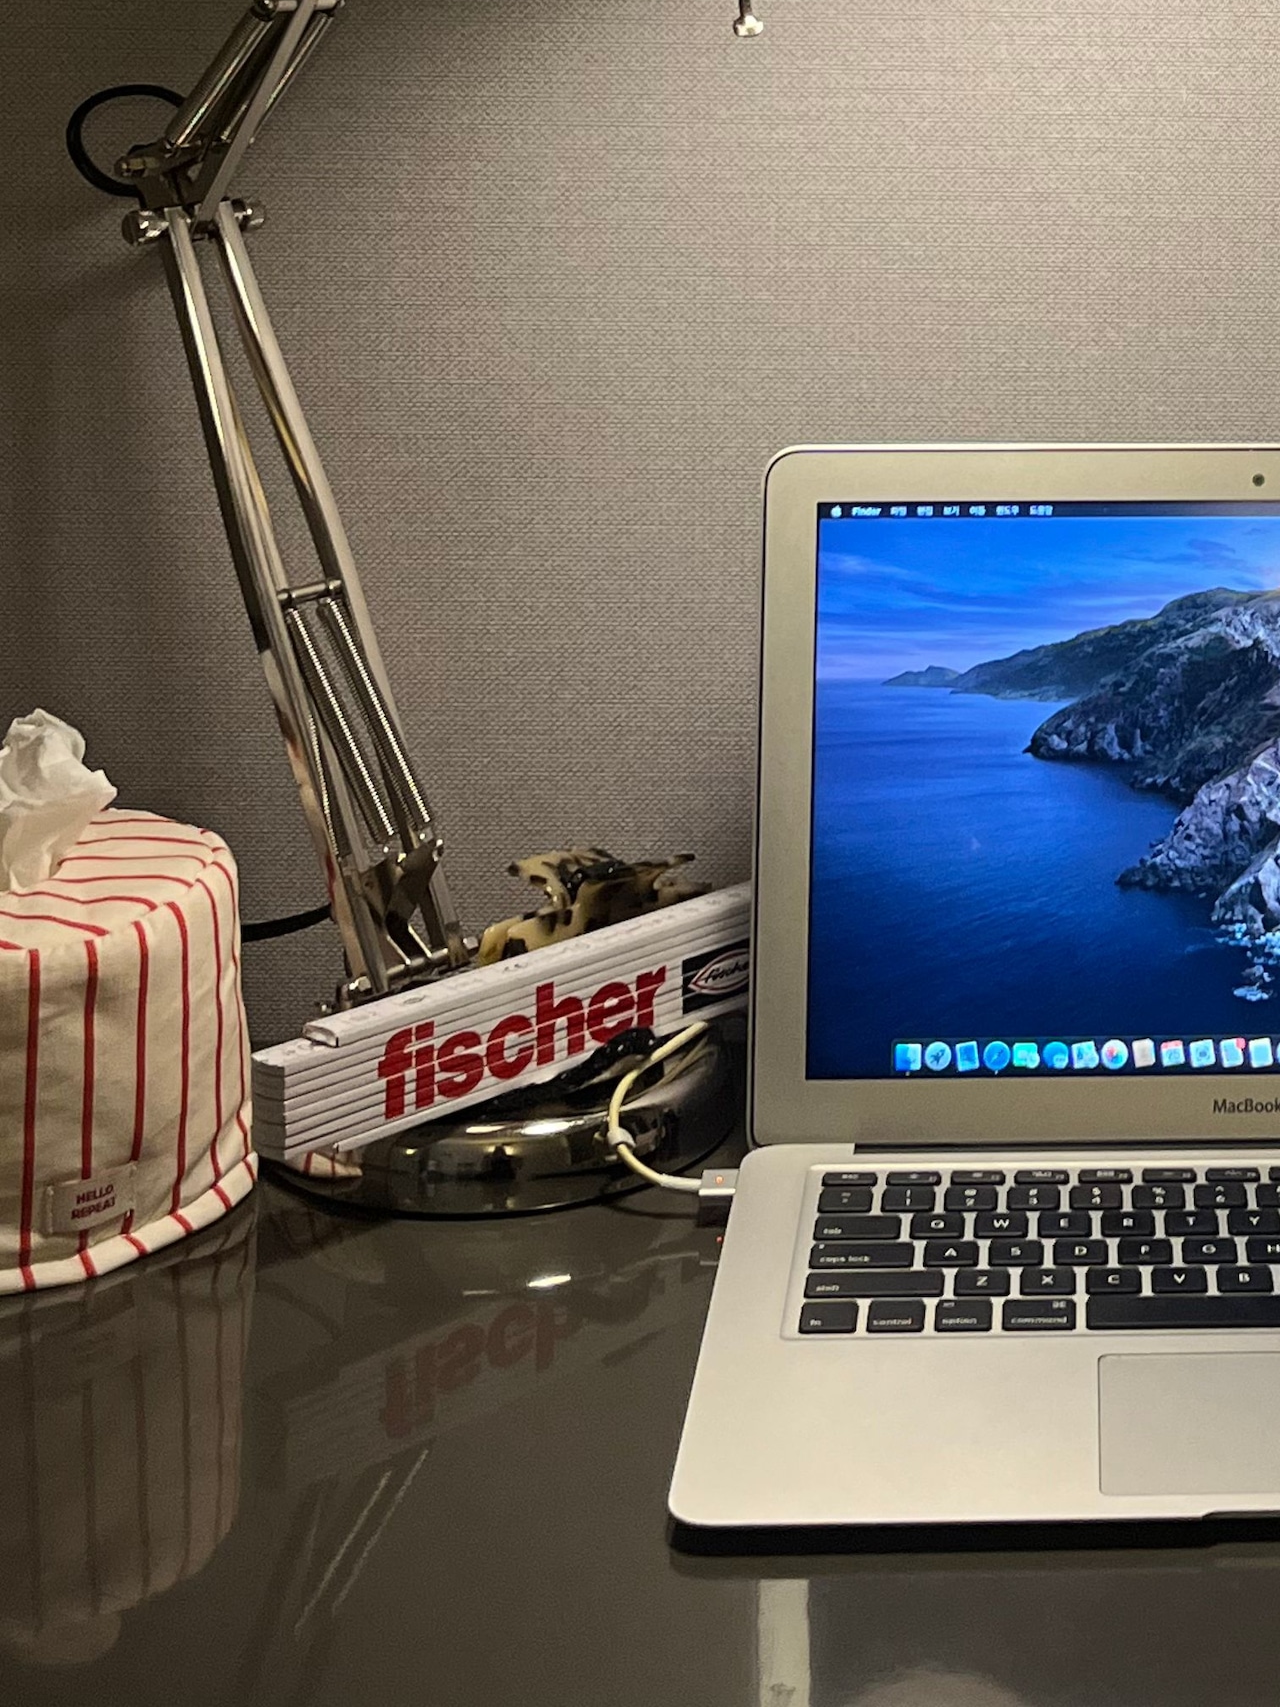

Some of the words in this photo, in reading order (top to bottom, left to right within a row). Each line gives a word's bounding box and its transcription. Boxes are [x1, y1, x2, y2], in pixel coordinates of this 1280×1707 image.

[378, 964, 668, 1120] fischer
[76, 1184, 114, 1205] HELLO
[70, 1193, 116, 1220] REPEAT
[993, 1218, 1010, 1229] W
[1060, 1217, 1069, 1228] E
[1186, 1216, 1196, 1226] T
[1249, 1216, 1260, 1226] Y
[944, 1247, 958, 1257] A
[1010, 1246, 1021, 1256] S
[1074, 1245, 1088, 1256] D
[1266, 1243, 1280, 1253] H
[975, 1275, 988, 1286] Z
[1041, 1274, 1054, 1285] X
[1107, 1273, 1120, 1284] C
[1173, 1273, 1186, 1284] V
[1238, 1272, 1251, 1283] B
